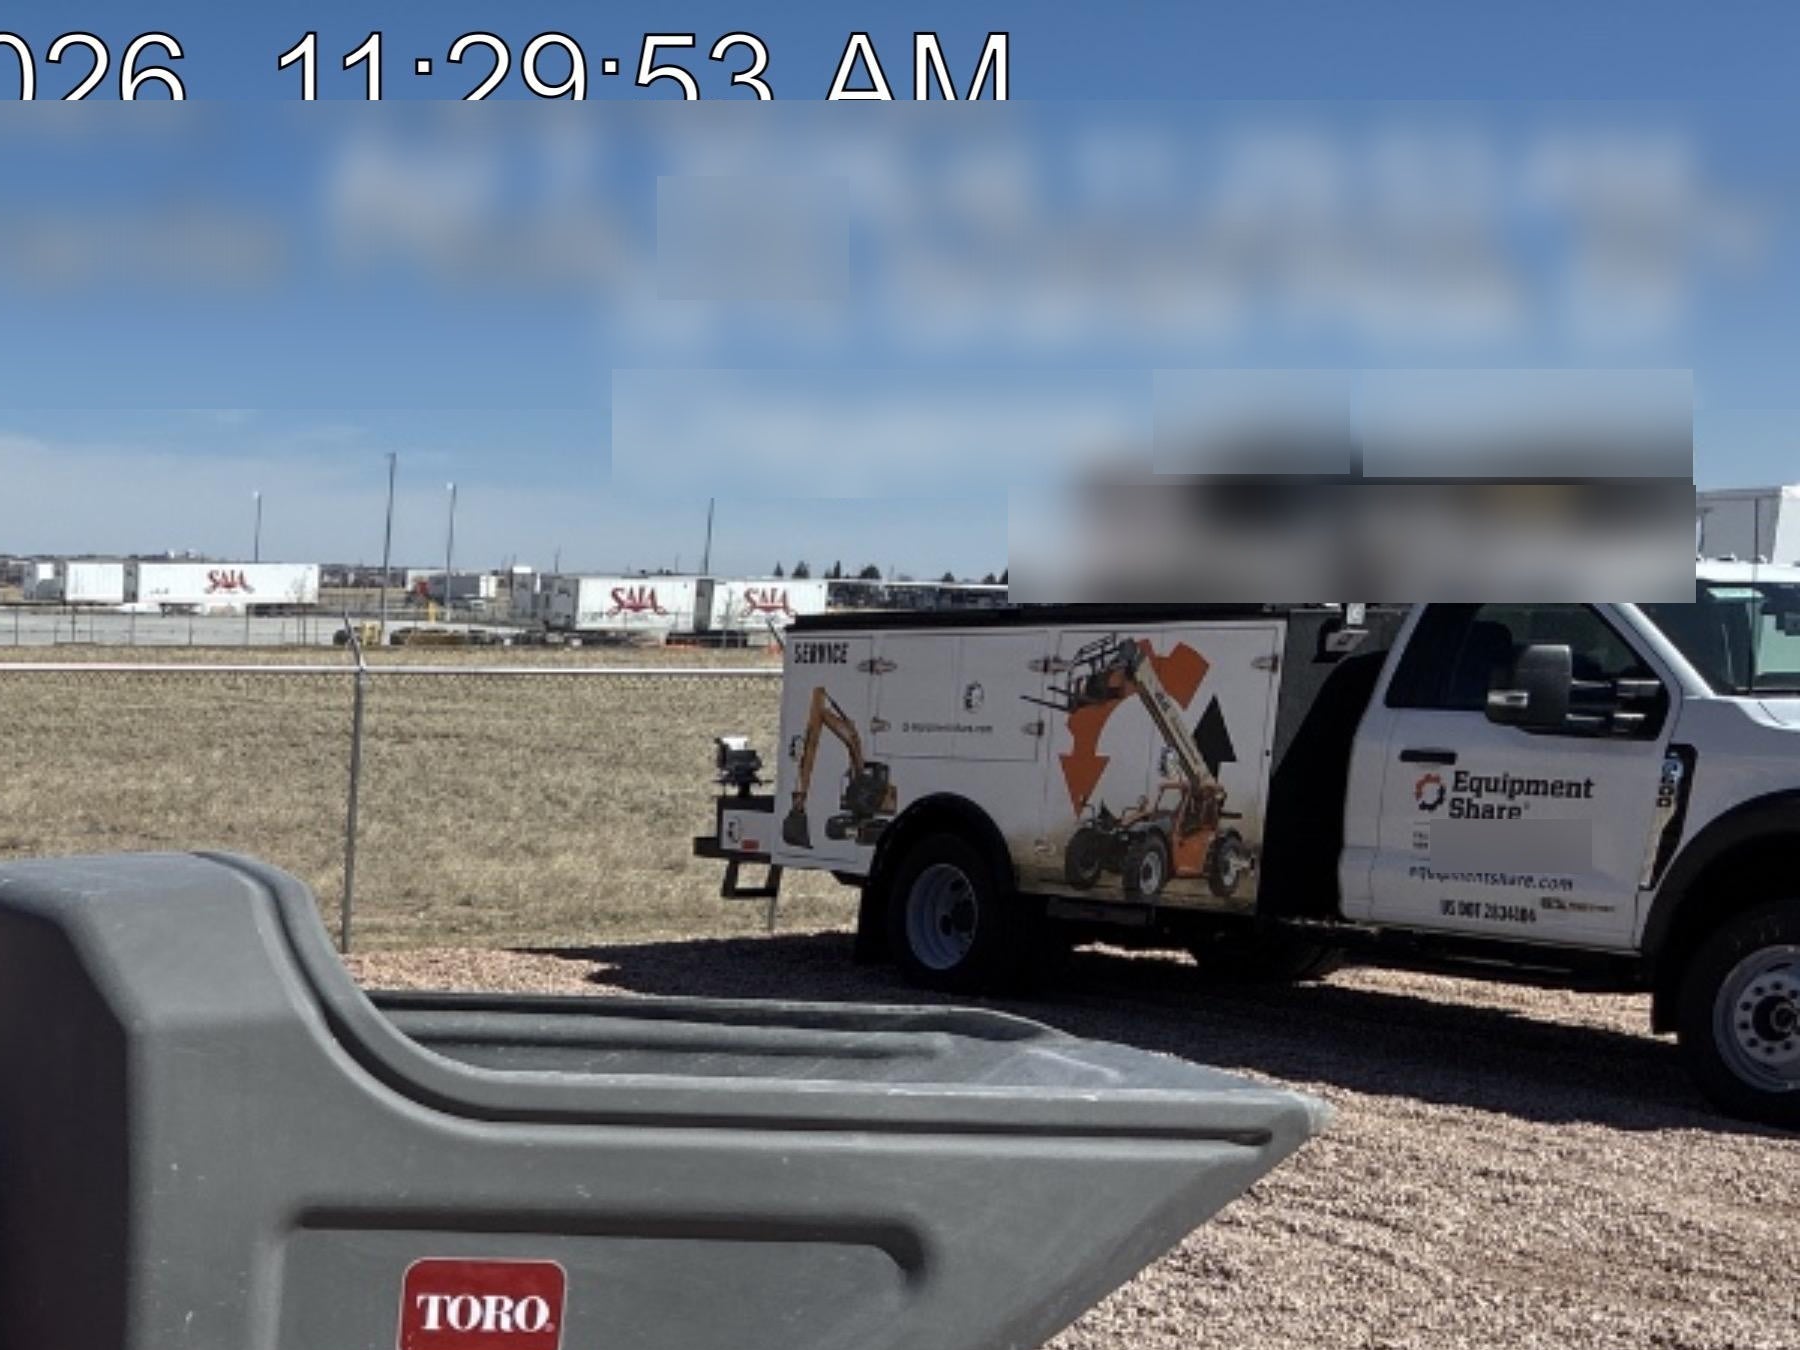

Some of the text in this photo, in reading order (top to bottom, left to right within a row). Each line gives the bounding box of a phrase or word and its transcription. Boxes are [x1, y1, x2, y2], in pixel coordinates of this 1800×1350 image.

[607, 585, 667, 617] SAIA
[743, 586, 799, 617] SAIA
[1452, 770, 1595, 800] Equipment
[1449, 797, 1523, 819] Share
[416, 1295, 551, 1331] TORO
